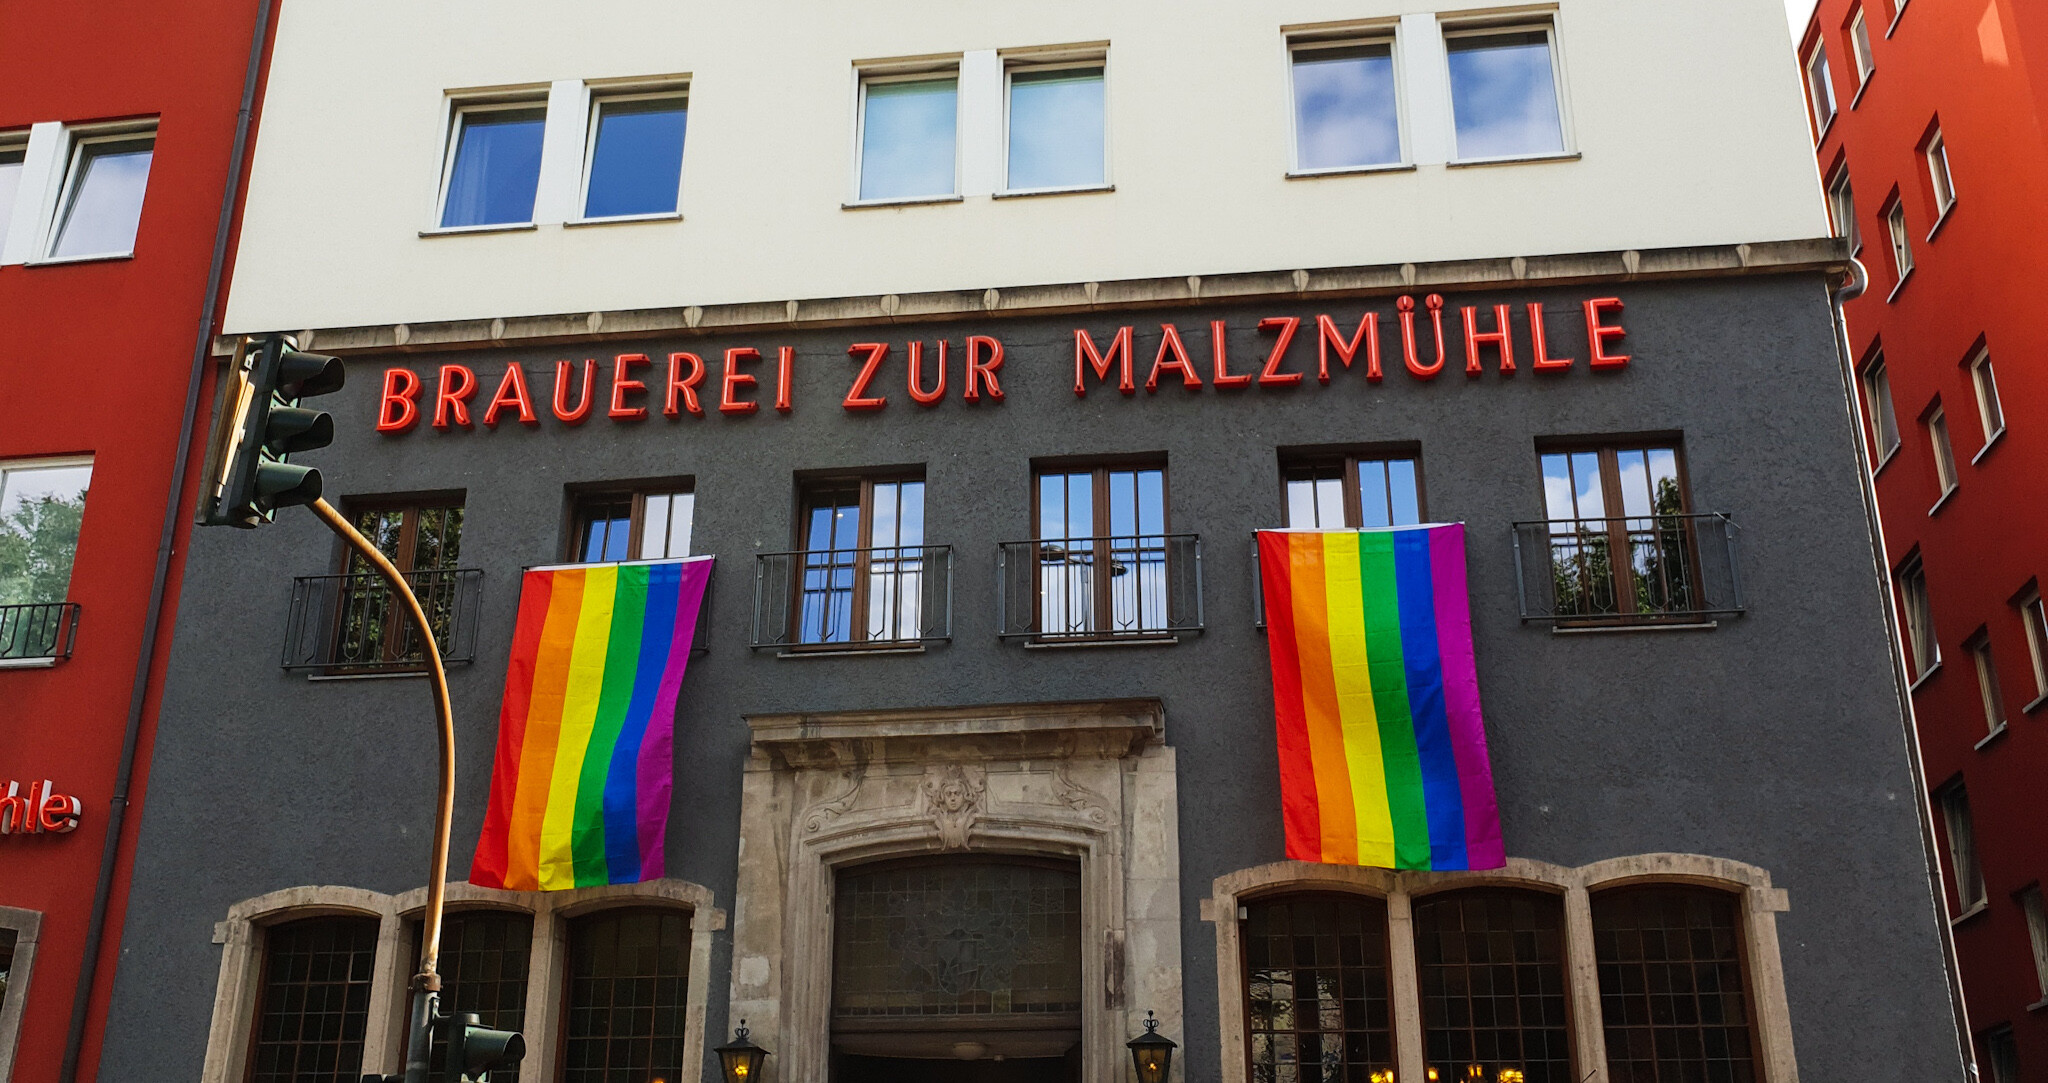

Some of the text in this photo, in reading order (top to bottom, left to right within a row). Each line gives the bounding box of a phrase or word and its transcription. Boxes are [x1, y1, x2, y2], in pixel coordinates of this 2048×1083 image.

[375, 293, 1632, 432] BRAUEREI ZUR MALZMÜHLE
